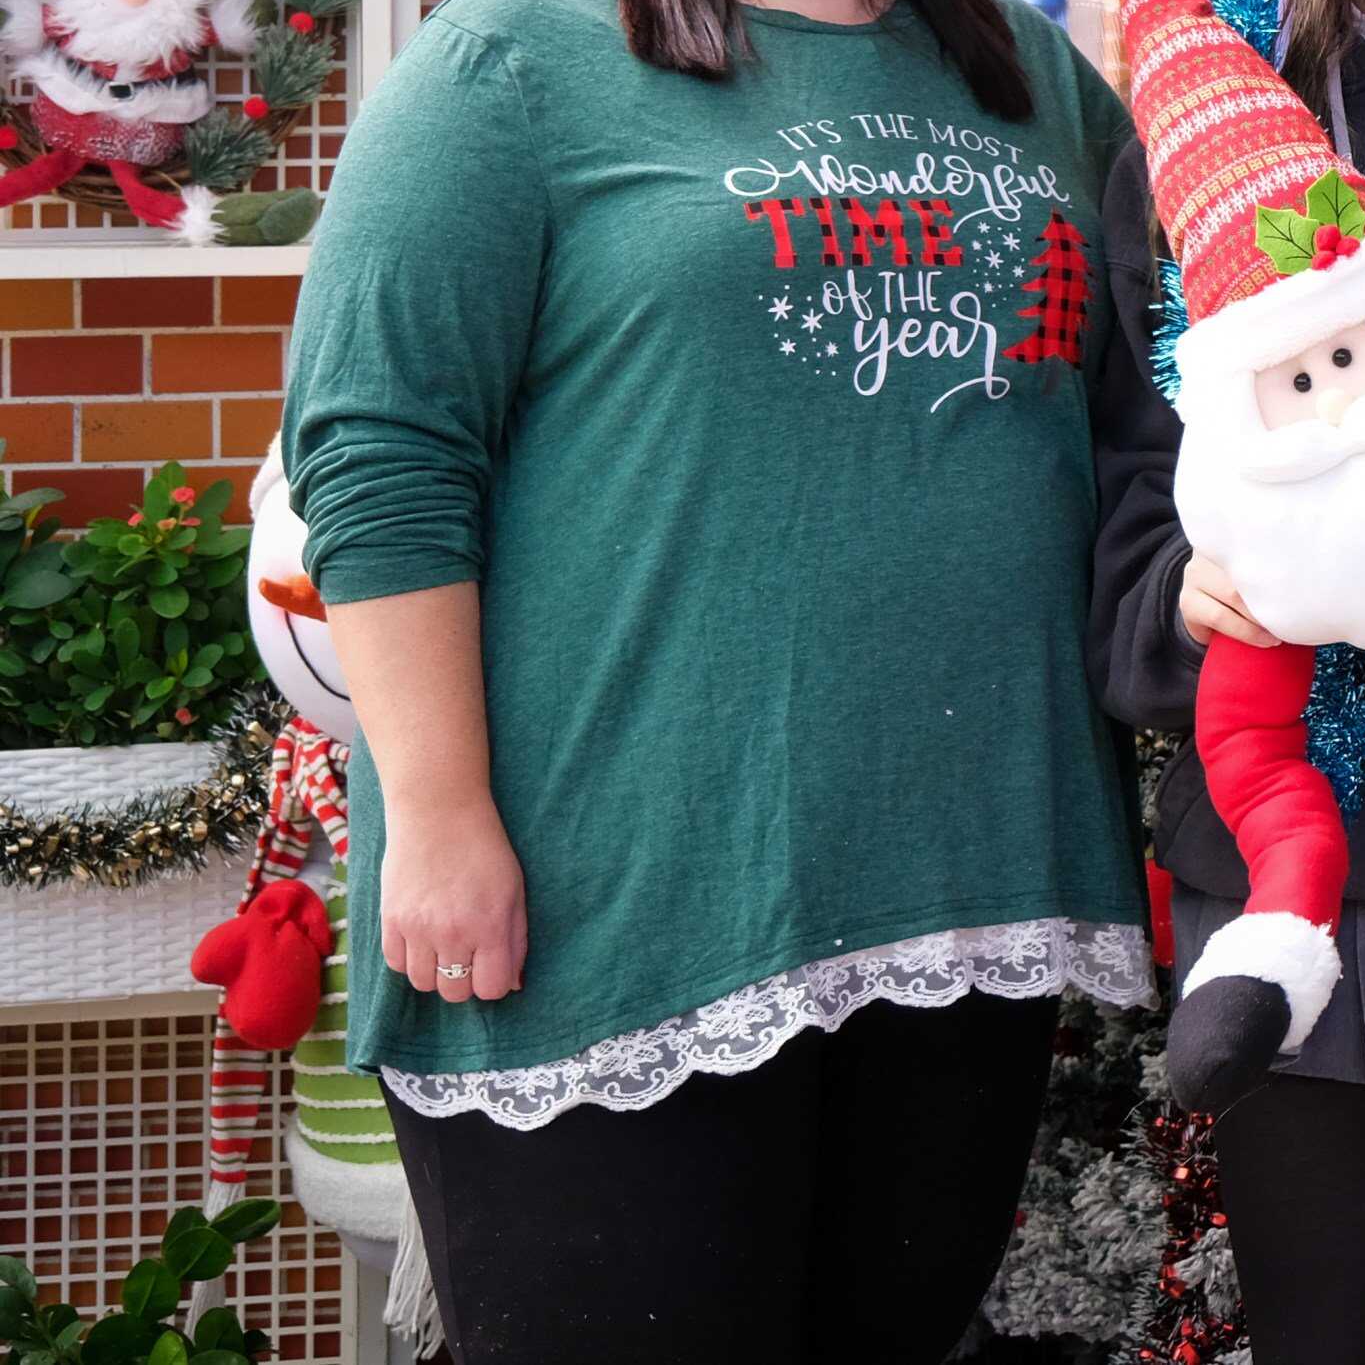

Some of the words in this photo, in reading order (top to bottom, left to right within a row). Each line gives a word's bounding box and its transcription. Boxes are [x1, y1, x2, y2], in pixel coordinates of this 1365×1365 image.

[777, 119, 842, 151] IT'S
[851, 113, 918, 140] THE
[927, 118, 1024, 164] MOST
[744, 197, 964, 269] TIME
[822, 270, 872, 321] of
[878, 271, 943, 313] THE
[854, 291, 1010, 413] year
